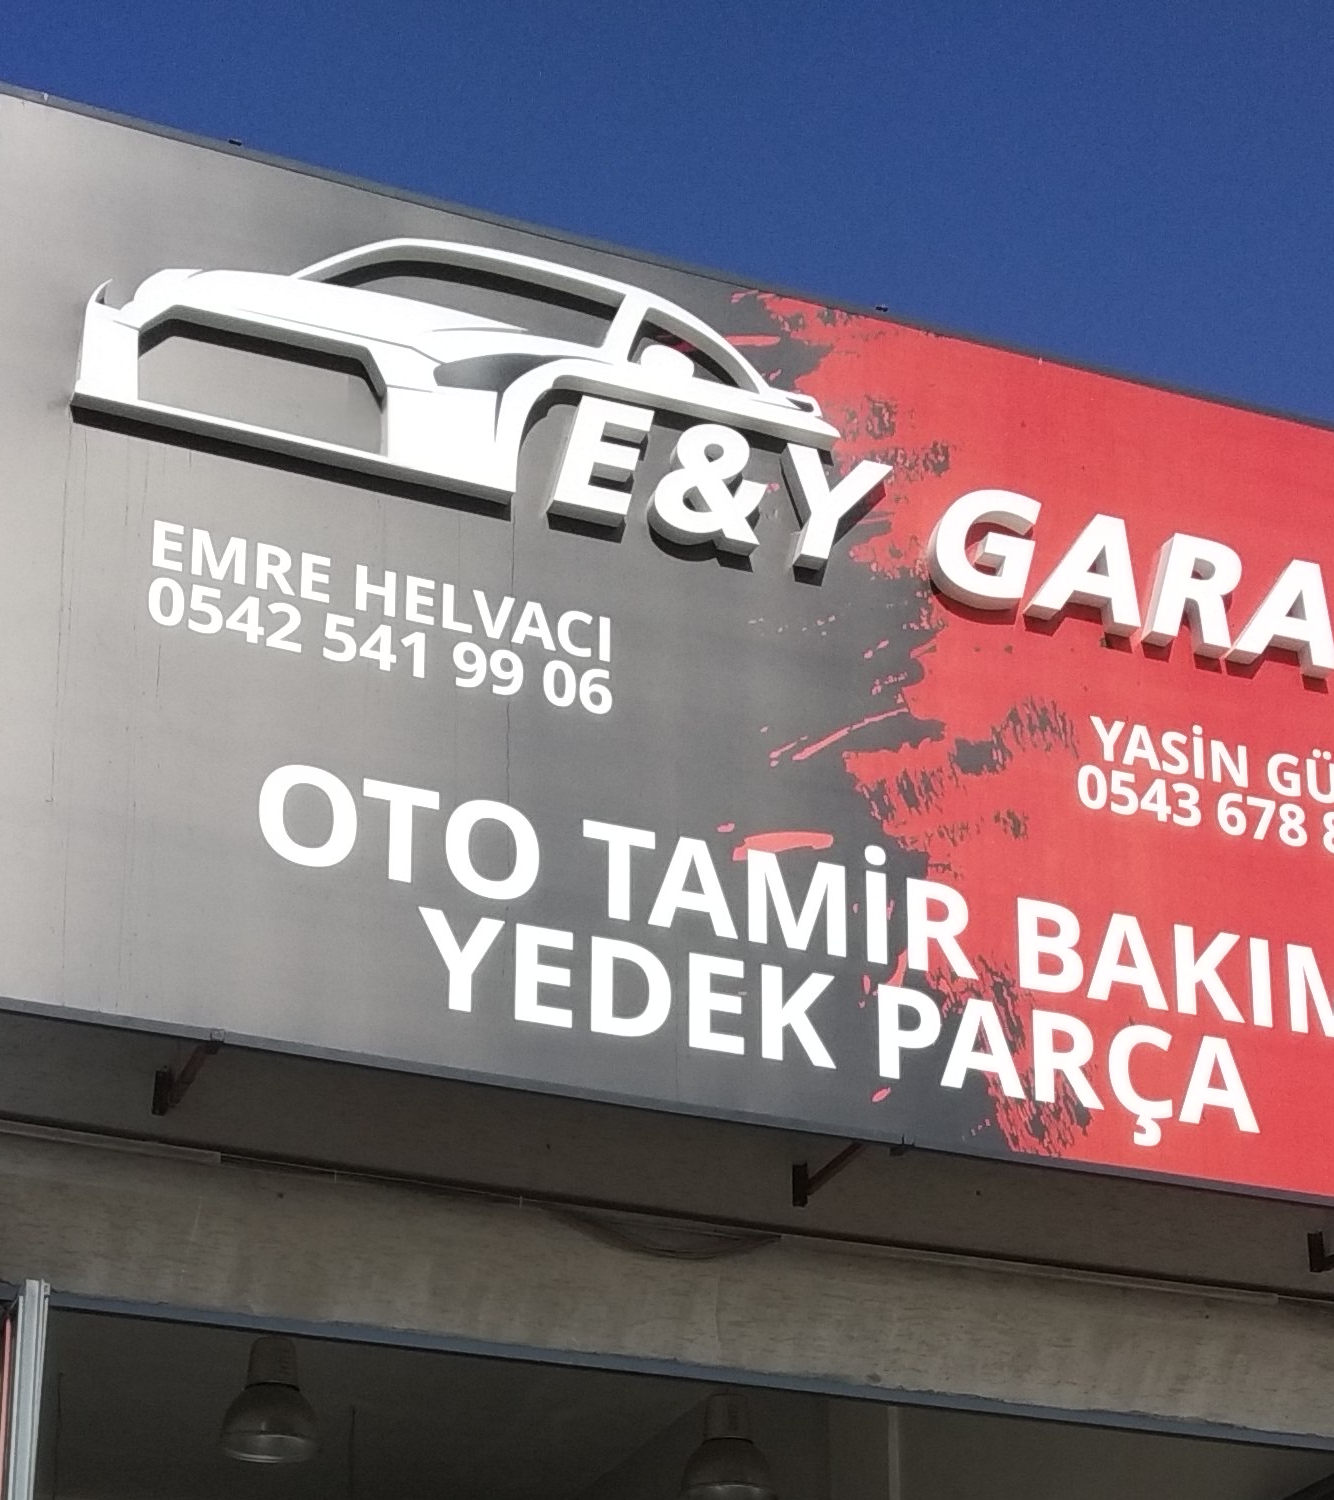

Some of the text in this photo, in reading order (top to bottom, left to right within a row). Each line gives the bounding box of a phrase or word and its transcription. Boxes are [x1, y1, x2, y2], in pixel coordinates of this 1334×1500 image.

[548, 395, 894, 573] E&Y
[148, 576, 615, 715] 0542 541 99 06
[150, 518, 614, 664] EMRE HELVACI
[1076, 764, 1201, 828] 0543
[1216, 793, 1309, 848] 678
[1088, 714, 1251, 790] YASİN
[257, 762, 541, 901] OTO
[581, 816, 981, 981] TAMİR
[417, 904, 1262, 1147] YEDEK PARÇA
